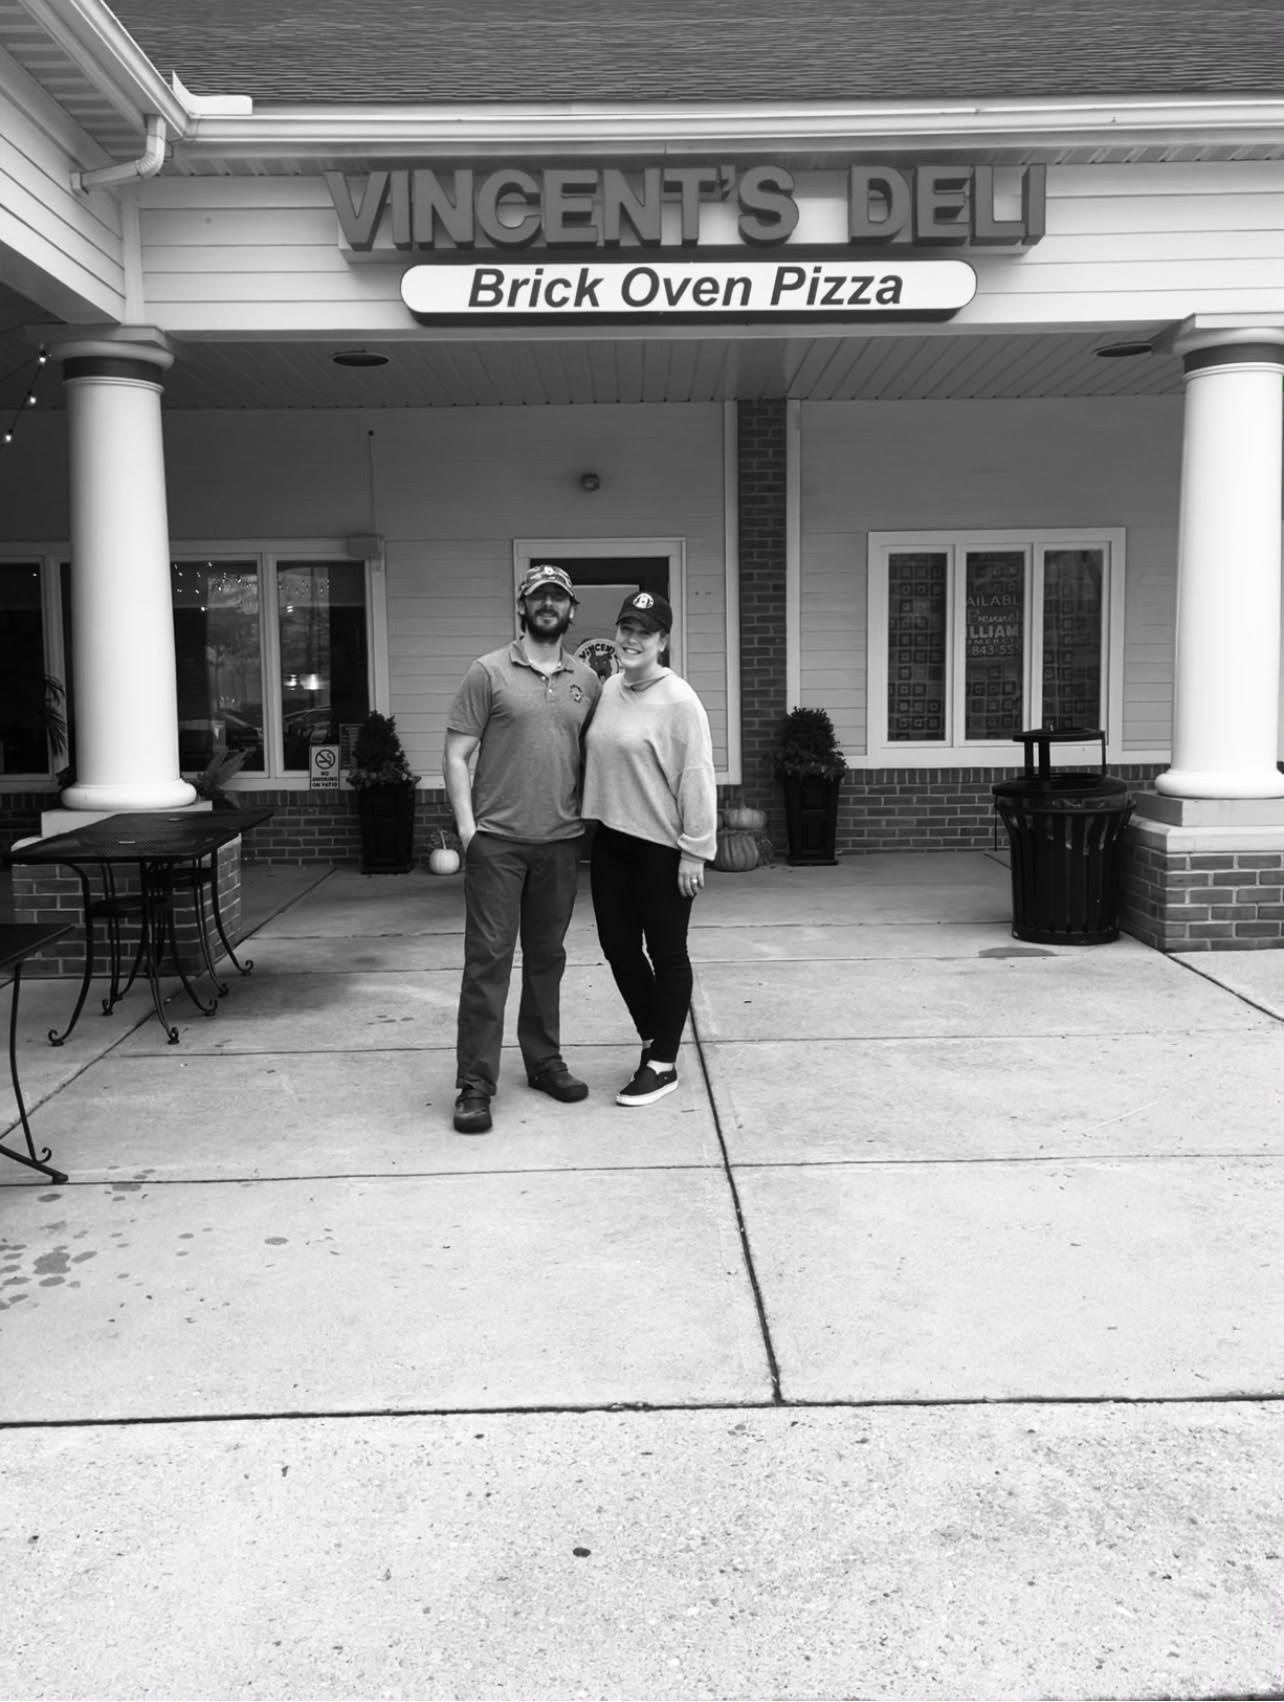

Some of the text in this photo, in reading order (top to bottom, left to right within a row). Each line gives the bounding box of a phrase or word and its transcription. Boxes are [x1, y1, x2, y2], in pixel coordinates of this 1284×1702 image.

[323, 163, 1046, 249] VINCENT'S DELI
[468, 265, 903, 308] Brick Oven Pizza
